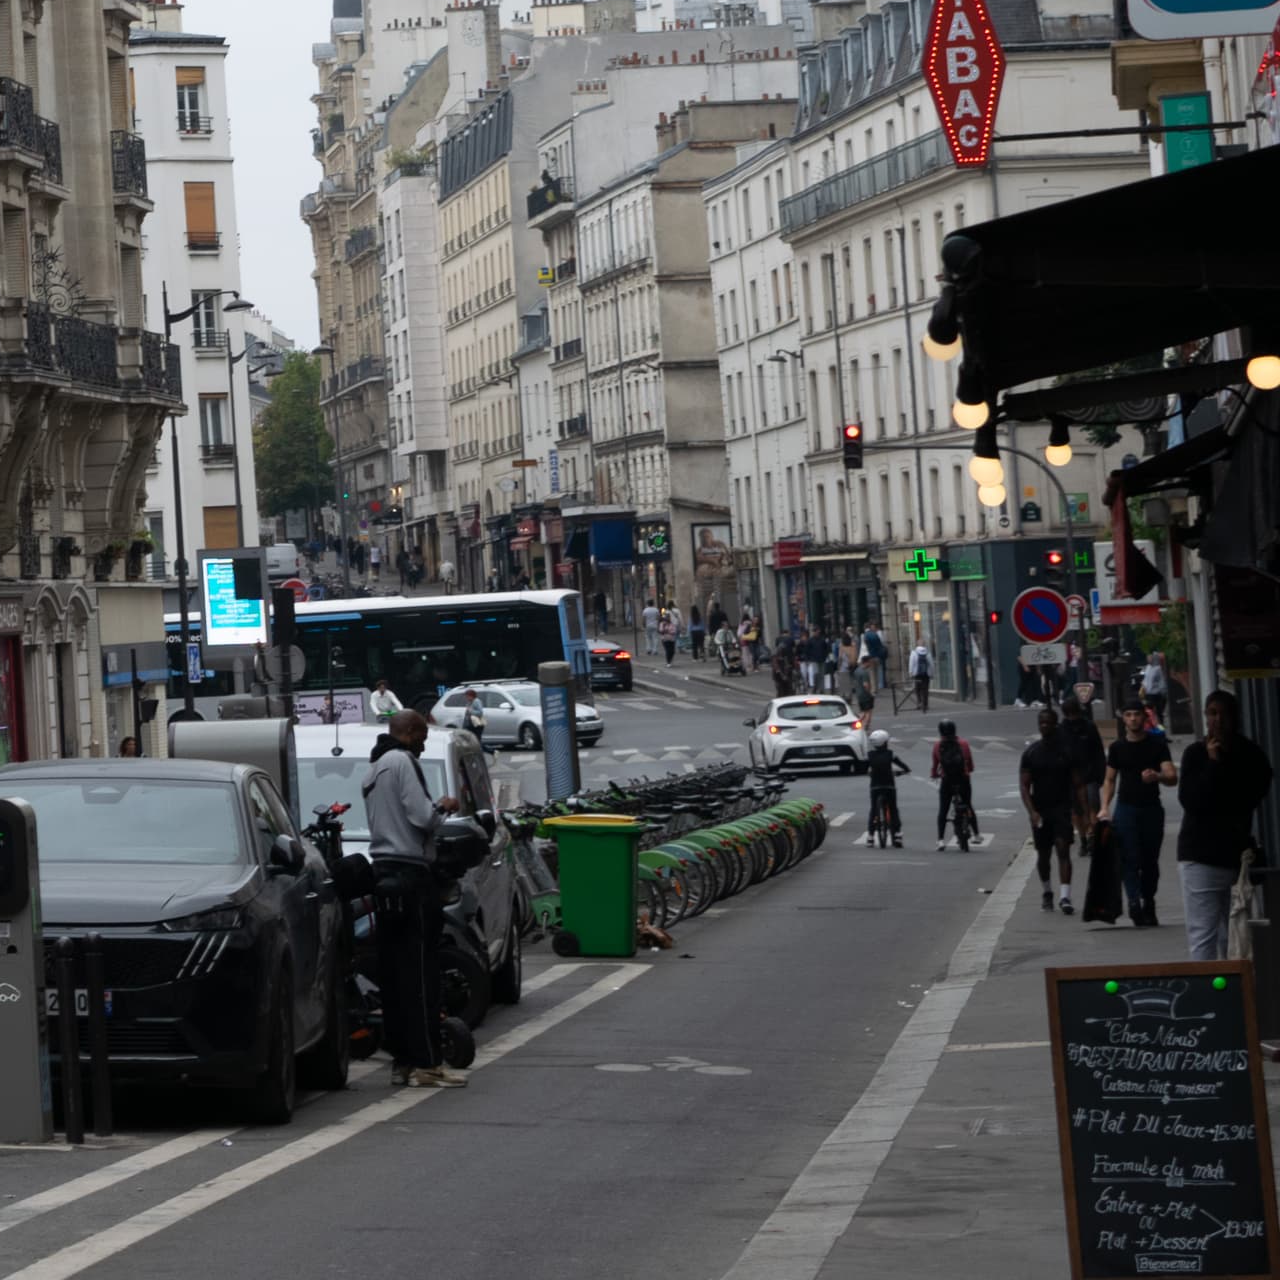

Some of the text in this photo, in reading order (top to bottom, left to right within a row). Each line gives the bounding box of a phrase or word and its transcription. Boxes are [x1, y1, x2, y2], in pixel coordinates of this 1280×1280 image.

[1092, 1154, 1158, 1176] Formule
[1162, 1156, 1185, 1178] du
[1096, 1231, 1129, 1250] Plat
